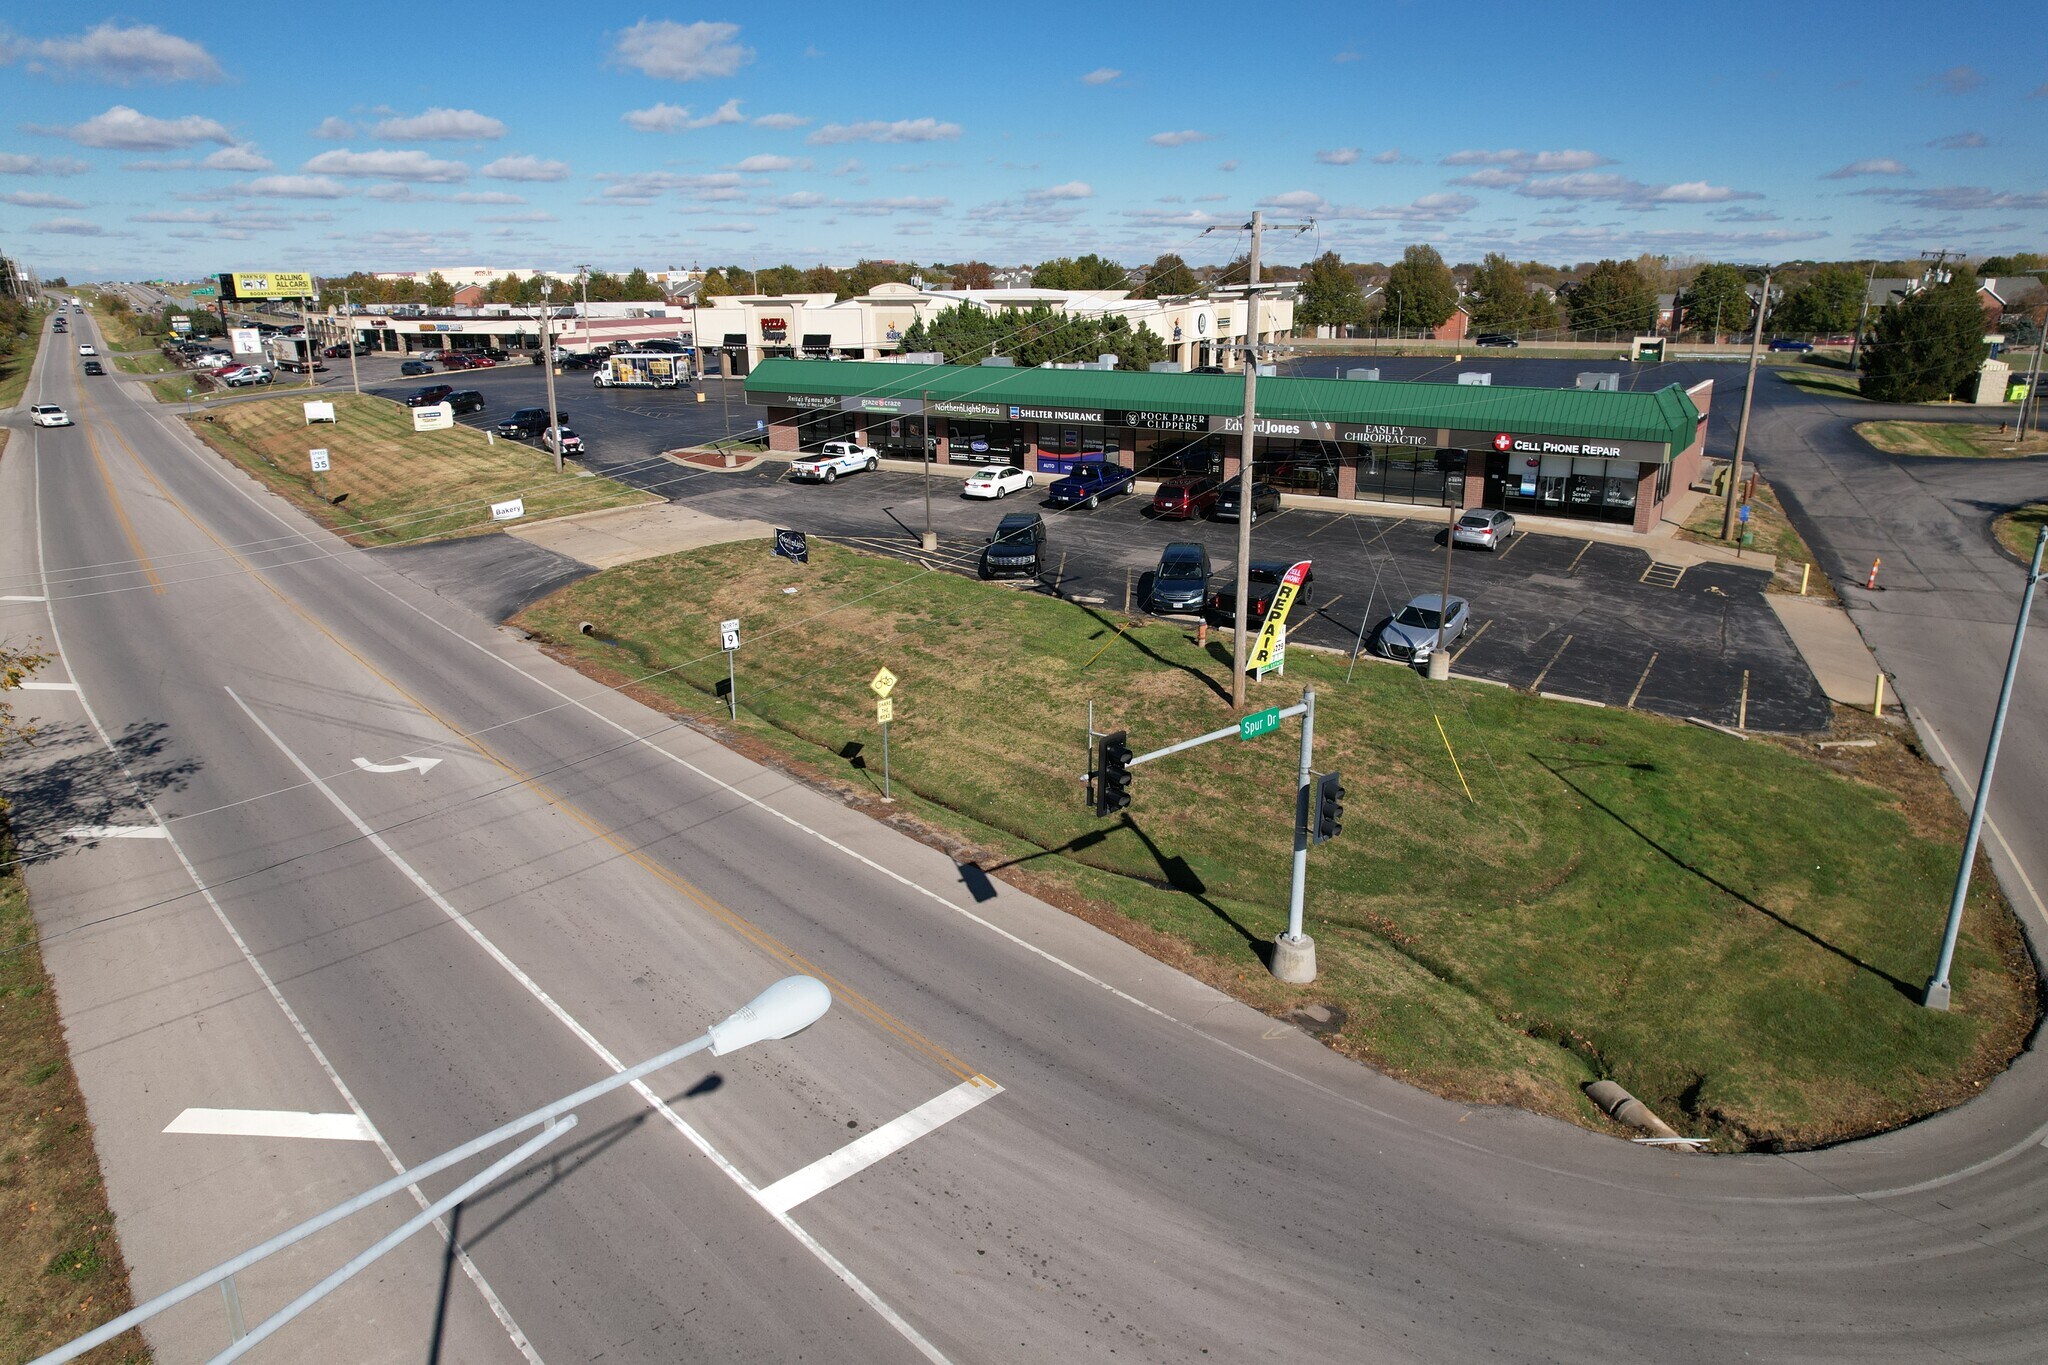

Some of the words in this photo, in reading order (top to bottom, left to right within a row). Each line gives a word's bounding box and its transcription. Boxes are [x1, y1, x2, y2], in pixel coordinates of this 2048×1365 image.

[760, 318, 787, 330] PIZZA
[982, 404, 1000, 415] Pizza
[1020, 409, 1053, 419] SHELTER
[1054, 411, 1102, 421] INSURANCE
[1140, 412, 1168, 420] ROCK
[1172, 414, 1205, 423] PAPER
[1147, 420, 1197, 430] CLIPPERS
[1224, 418, 1264, 432] Edrd
[1265, 420, 1300, 434] Jones
[1365, 424, 1406, 435] EASLEY
[1344, 432, 1426, 445] CHIROPRACTIC
[1514, 440, 1540, 451] CELL
[1543, 442, 1579, 453] PHONE
[1582, 444, 1620, 456] REPAIR
[496, 506, 520, 515] Bakery
[1257, 586, 1292, 662] REPAIR
[728, 635, 733, 644] 9
[1244, 720, 1263, 735] Spur
[1268, 714, 1277, 726] Dr
